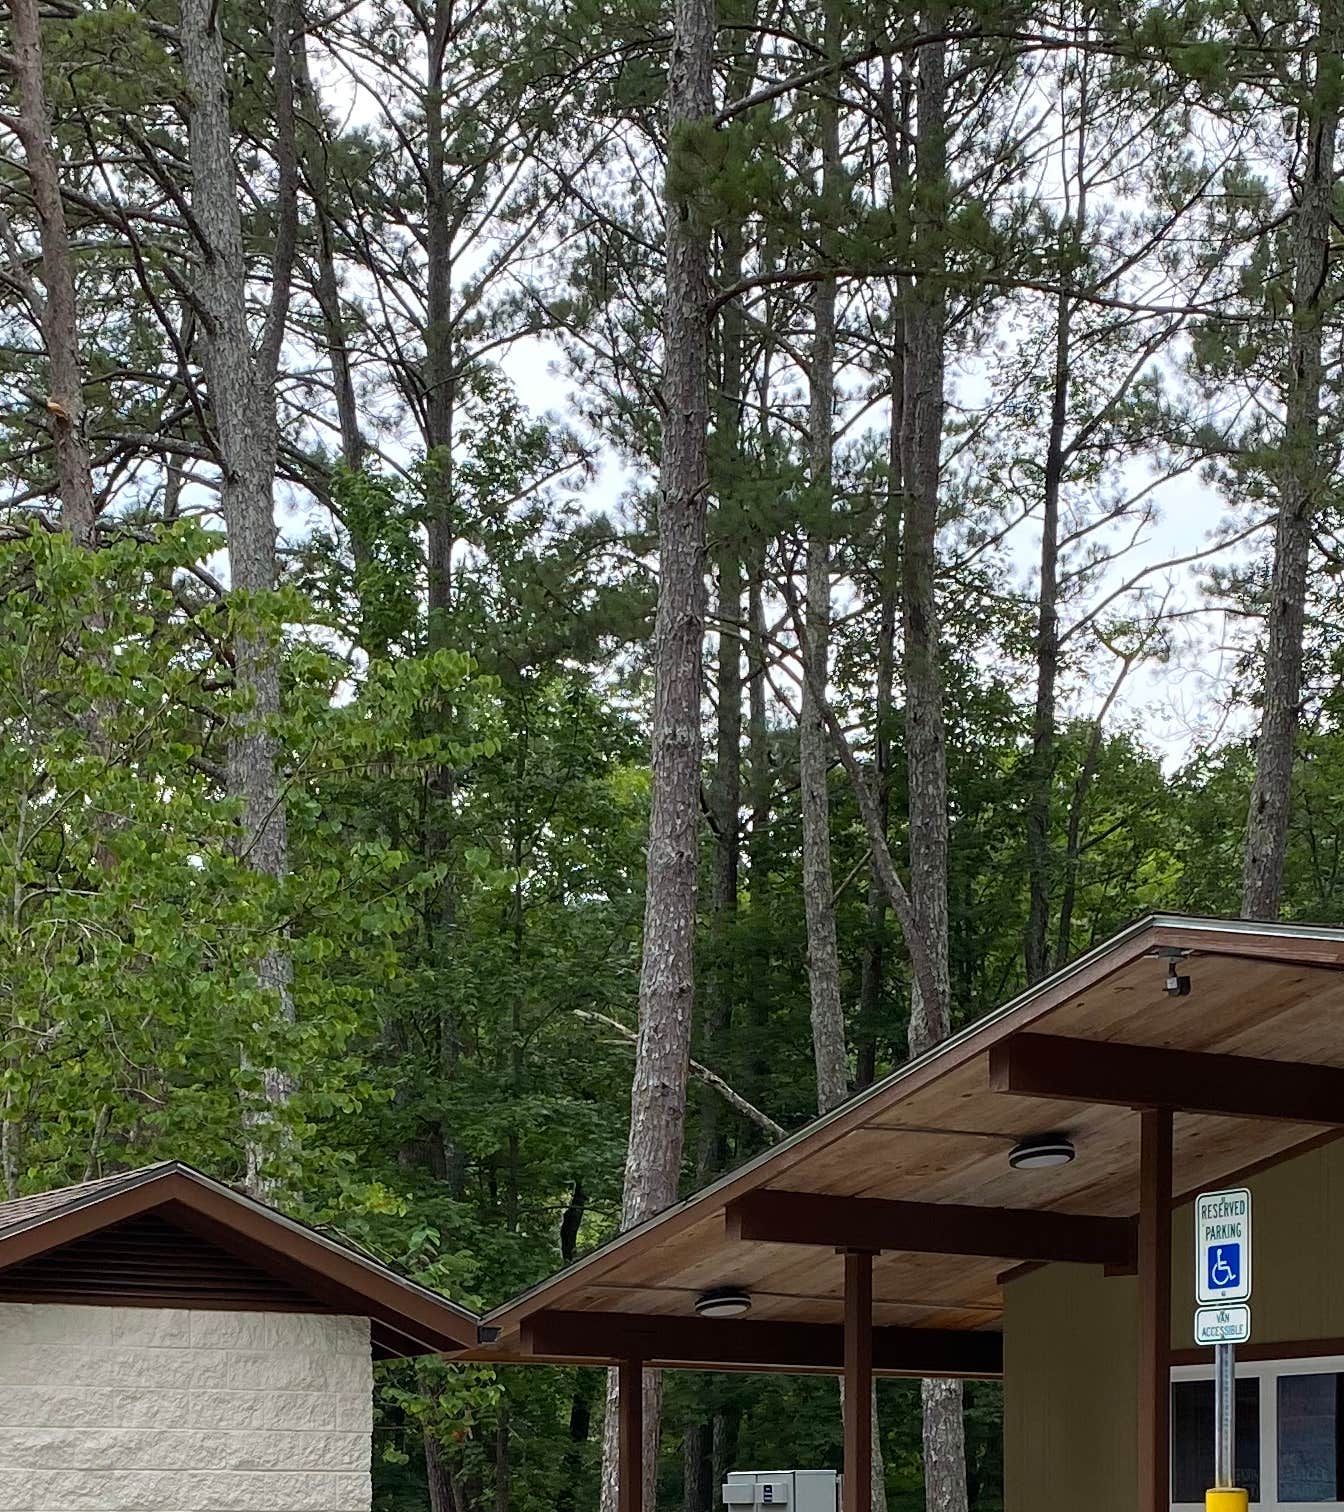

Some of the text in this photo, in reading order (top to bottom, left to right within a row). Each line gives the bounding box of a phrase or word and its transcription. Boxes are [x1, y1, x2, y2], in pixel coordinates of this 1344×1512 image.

[1201, 1200, 1246, 1220] RESERVED
[1205, 1222, 1242, 1241] PARKING
[1216, 1312, 1230, 1324] VAN
[1201, 1324, 1244, 1337] ACCESSIBLE
